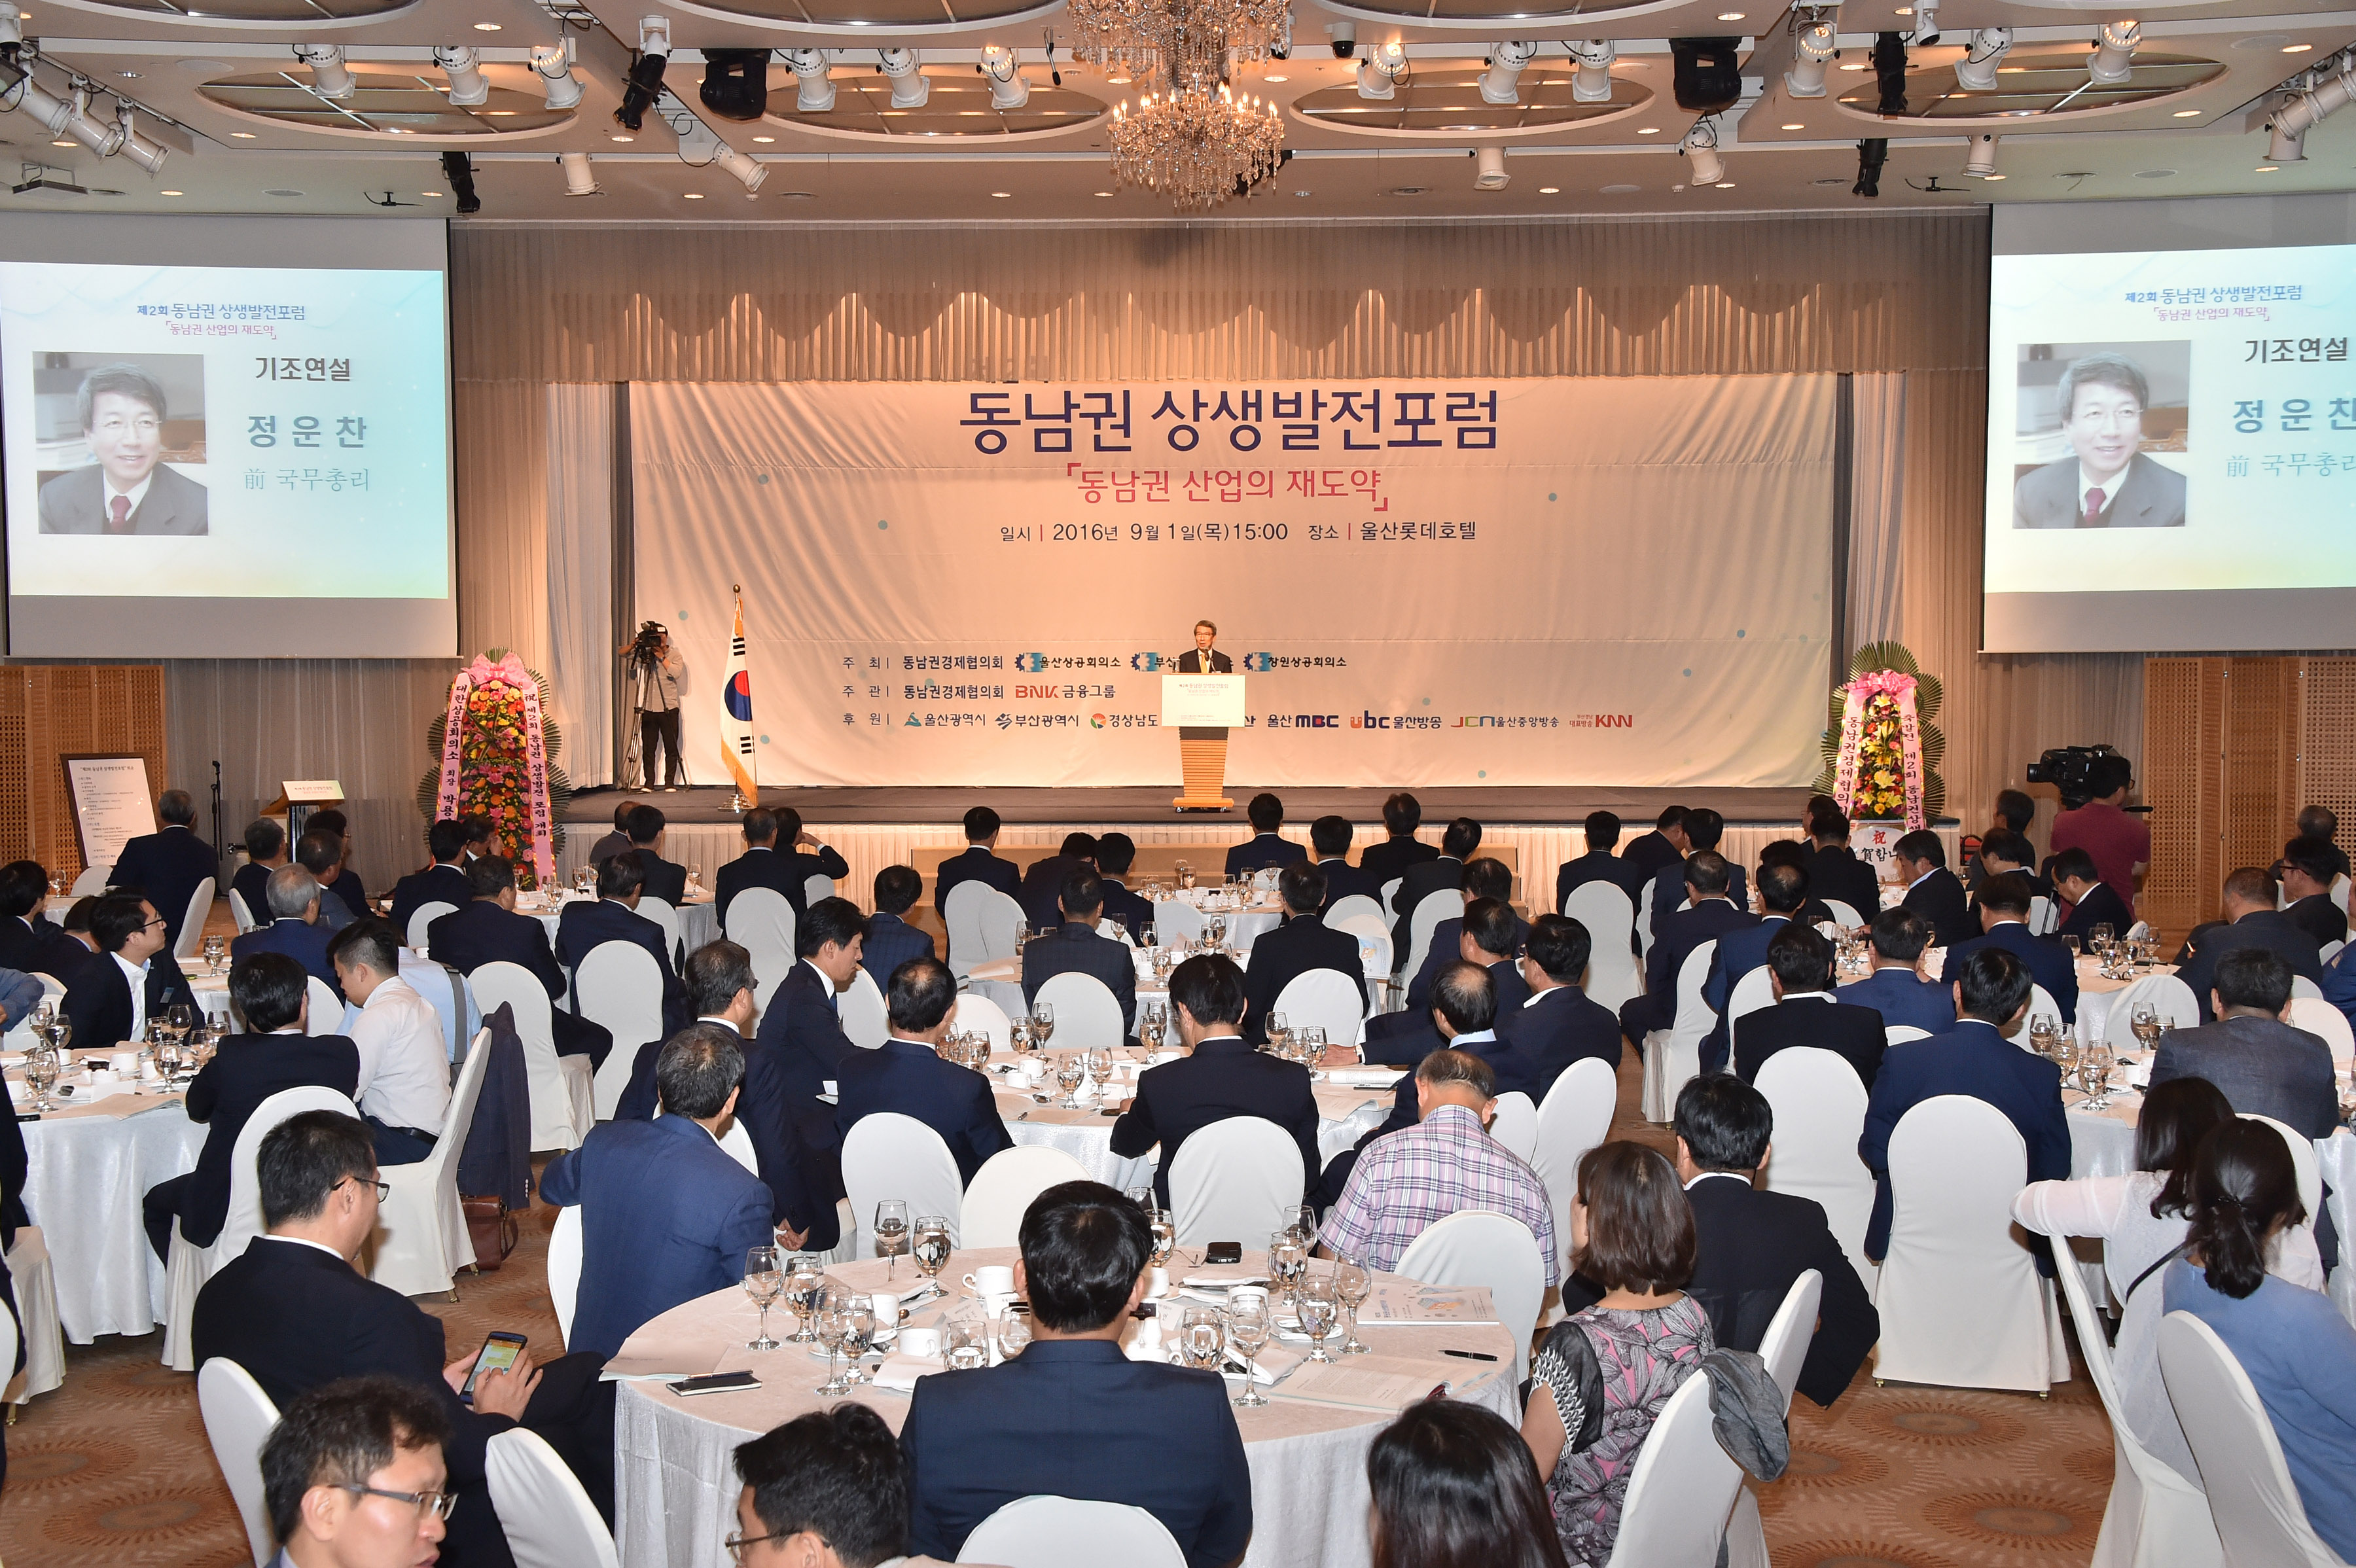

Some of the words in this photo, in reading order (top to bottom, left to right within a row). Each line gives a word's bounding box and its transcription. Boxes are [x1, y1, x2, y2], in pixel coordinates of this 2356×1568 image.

[2124, 291, 2157, 303] 제2회
[2160, 287, 2205, 304] 동남권
[2209, 285, 2303, 303] 상생발전포럼
[137, 304, 168, 317] 제2회
[171, 302, 215, 320] 동남권
[219, 303, 306, 321] 상생발전포럼
[2195, 307, 2229, 320] 산업의
[206, 324, 238, 336] 산업의
[2245, 336, 2348, 365] 기조연설
[255, 357, 351, 382] 기조연설
[960, 389, 1132, 454] 동남권
[1151, 389, 1497, 452] 상생발전포럼
[2226, 455, 2249, 478] 前
[244, 469, 265, 491] 前
[276, 467, 370, 492] 국무총리
[1183, 470, 1274, 503] 산업의
[1000, 526, 1031, 542] 일시
[1052, 524, 1118, 542] 2016년
[1130, 523, 1159, 541] 9월
[1308, 524, 1340, 541] 장소
[1360, 521, 1476, 541] 울산롯데호텔
[902, 656, 1003, 669] 동남권경제협의회
[1039, 656, 1121, 668] 울산상공회의소
[1268, 656, 1347, 668] 창원상공회의소
[524, 694, 537, 702] 祝
[904, 685, 1004, 699] 동남권경제협의회
[445, 684, 468, 760] 대한상공회의소
[526, 706, 538, 730] 제2회
[924, 713, 986, 726] 울산광역시
[1016, 715, 1079, 727] 부산광역시
[1109, 714, 1158, 727] 경상남도
[1595, 714, 1632, 728] KNN
[529, 734, 543, 758] 동남권
[1904, 751, 1916, 779] 제2회
[445, 770, 456, 786] 회장
[531, 763, 544, 796] 상생발전
[440, 794, 457, 821] 박용
[533, 802, 546, 817] 포럼
[535, 821, 546, 837] 개최
[1872, 830, 1887, 844] 祝
